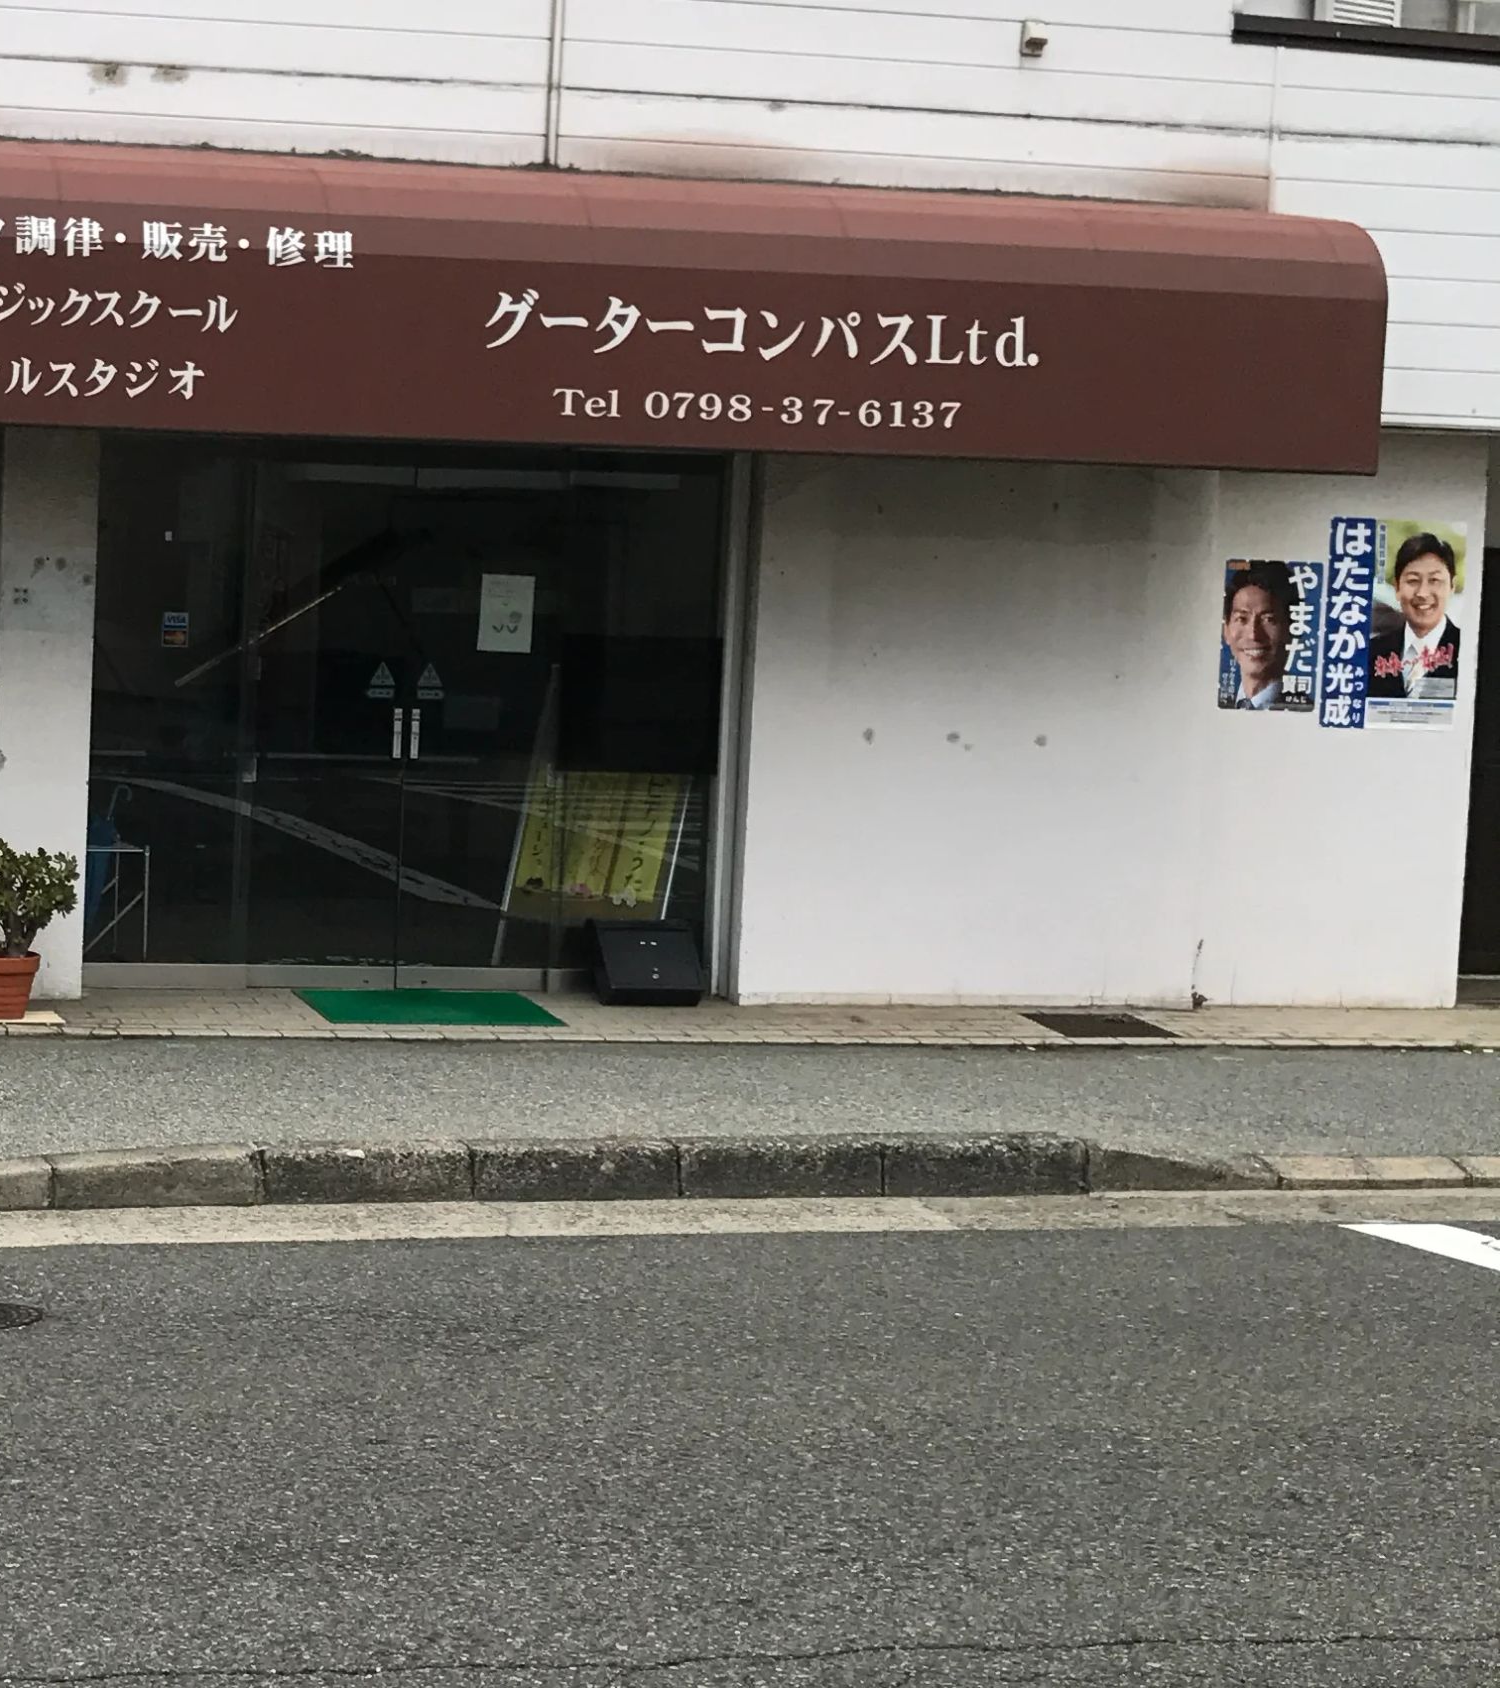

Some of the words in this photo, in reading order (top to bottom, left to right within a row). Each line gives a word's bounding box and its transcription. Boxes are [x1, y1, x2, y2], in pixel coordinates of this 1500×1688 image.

[552, 388, 622, 419] Tel
[644, 391, 963, 429] 0798-37-6137
[166, 615, 187, 624] VISA
[1323, 522, 1372, 726] はたなか光成
